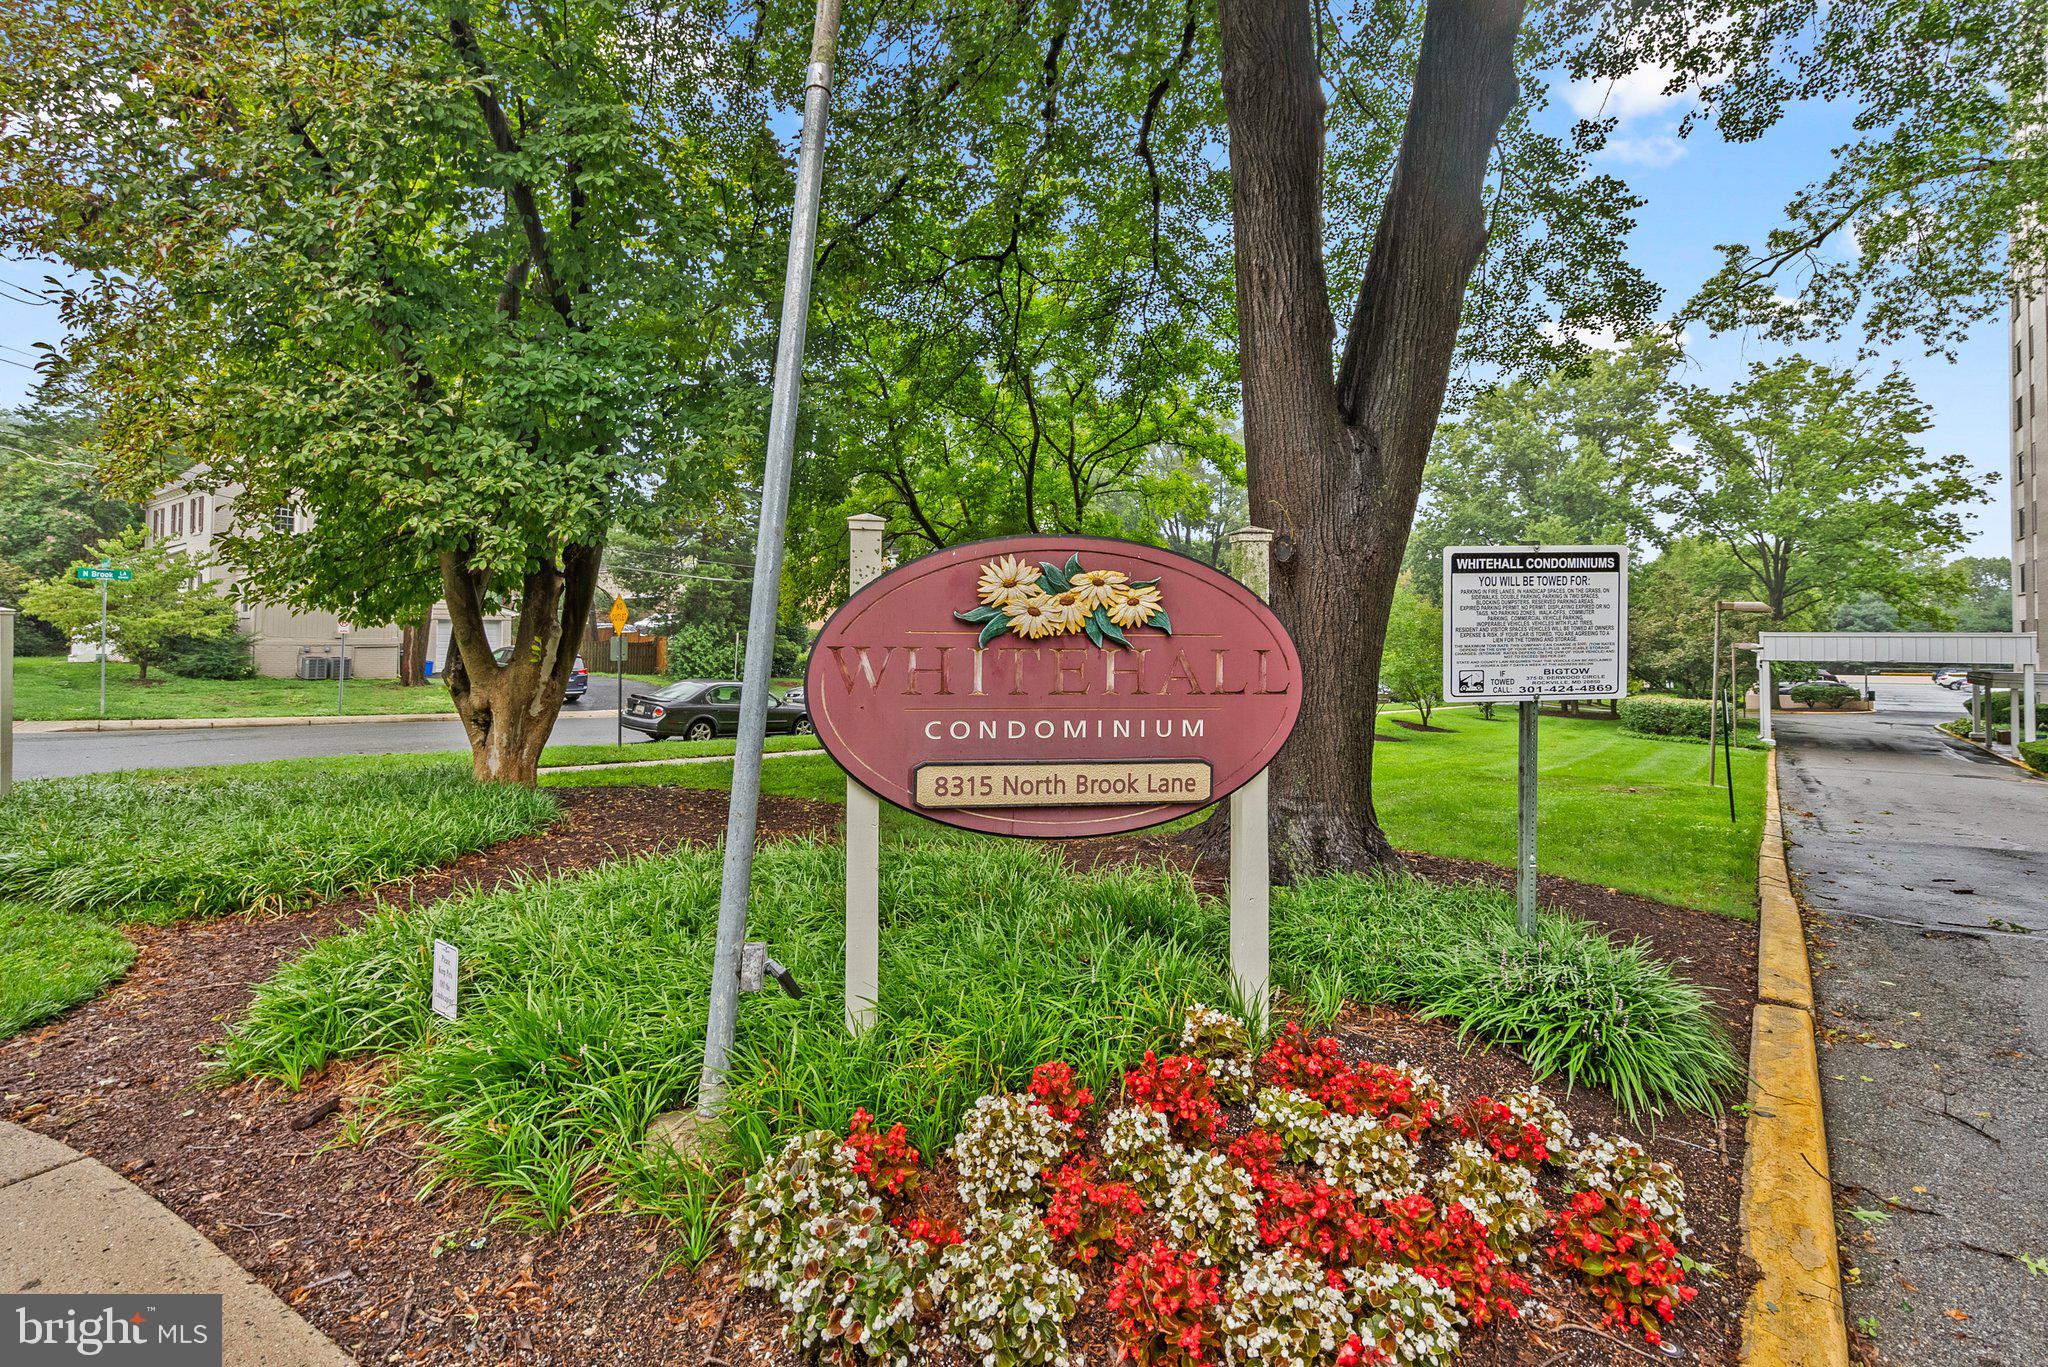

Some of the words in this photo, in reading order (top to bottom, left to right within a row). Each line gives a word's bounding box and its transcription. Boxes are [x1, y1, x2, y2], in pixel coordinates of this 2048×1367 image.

[1456, 558, 1523, 569] WHITEHALL
[1526, 557, 1615, 569] CONDOMINIUMS
[1479, 576, 1497, 587] YOU
[1499, 576, 1521, 586] WILL
[1523, 576, 1534, 586] BE
[1537, 576, 1568, 586] TOWED
[1570, 575, 1590, 586] FOR:
[826, 646, 1290, 696] WHITEHALL
[1519, 685, 1612, 693] 301-424-4869
[924, 718, 1205, 740] CONDOMINIUM
[934, 775, 993, 798] 8315
[1003, 773, 1066, 796] North
[1076, 772, 1139, 794] Brook
[1148, 774, 1196, 793] Lane
